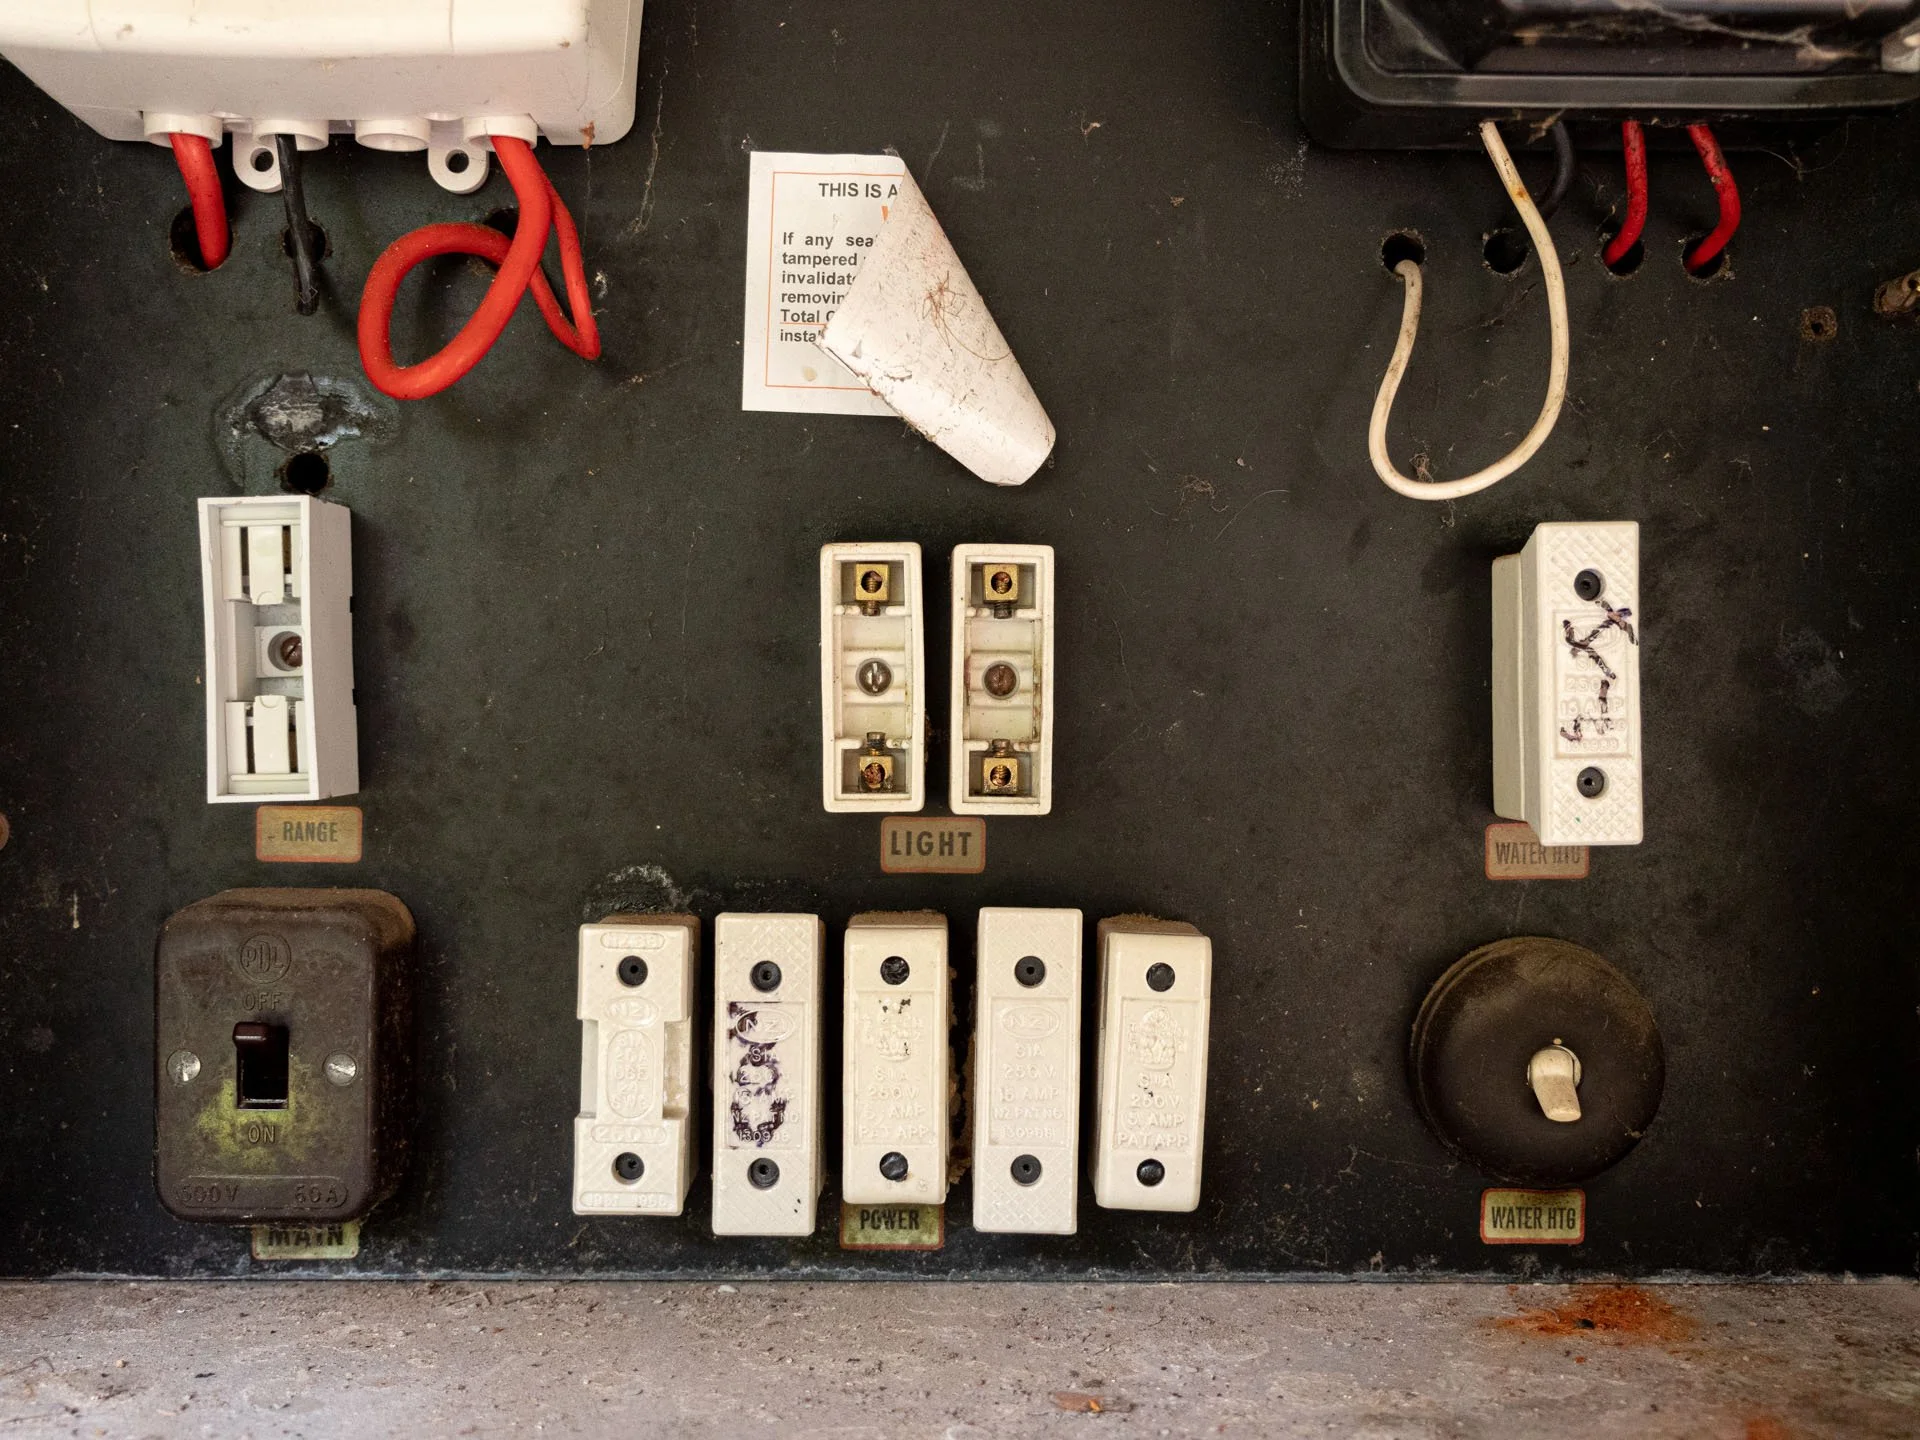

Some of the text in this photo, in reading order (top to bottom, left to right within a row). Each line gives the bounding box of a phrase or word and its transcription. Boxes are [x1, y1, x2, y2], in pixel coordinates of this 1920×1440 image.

[818, 182, 859, 198] THIS
[865, 183, 882, 199] IS
[783, 232, 878, 250] If any sea
[782, 252, 858, 268] tampered
[780, 308, 820, 323] Total
[282, 821, 339, 842] RANGE
[890, 830, 972, 856] LIGHT
[1495, 842, 1547, 865] WATER
[242, 940, 284, 973] PDL
[242, 991, 282, 1011] OFF
[1022, 1086, 1060, 1102] AMP
[1148, 1110, 1185, 1128] AMP
[247, 1124, 275, 1143] ON
[1117, 1131, 1189, 1148] PAT APP
[859, 1208, 920, 1231] POWER
[1491, 1206, 1577, 1230] WATER HTG
[266, 1226, 344, 1247] MAIN
